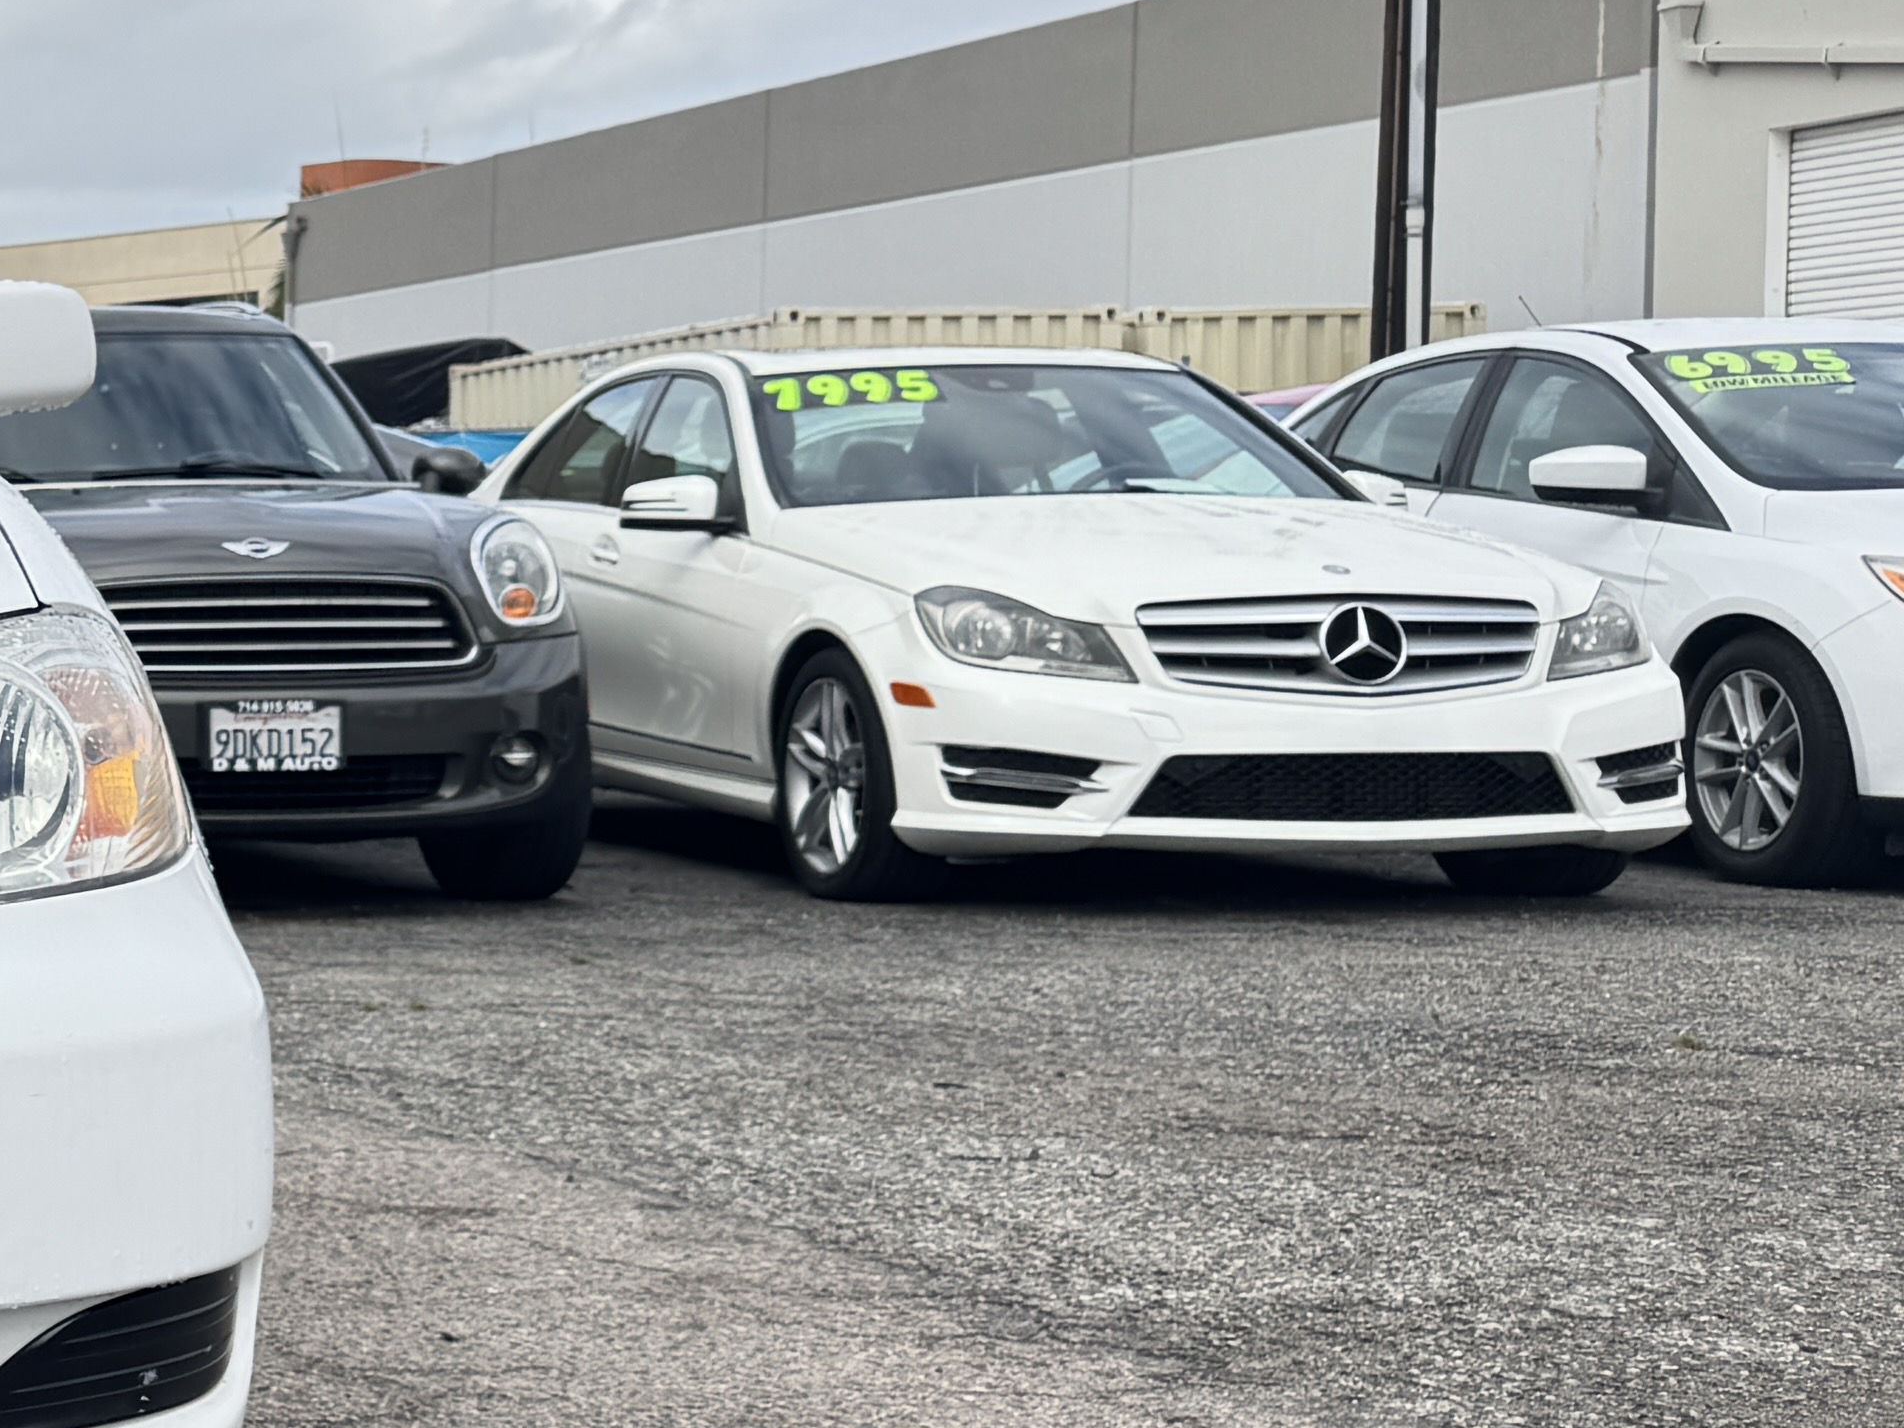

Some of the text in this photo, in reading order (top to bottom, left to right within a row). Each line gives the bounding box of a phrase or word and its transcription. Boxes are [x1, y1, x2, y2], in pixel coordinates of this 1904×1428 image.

[1665, 348, 1850, 378] 6995
[763, 369, 938, 411] 7995
[215, 728, 334, 759] 9DKD152
[212, 756, 338, 772] D & M AUTO
